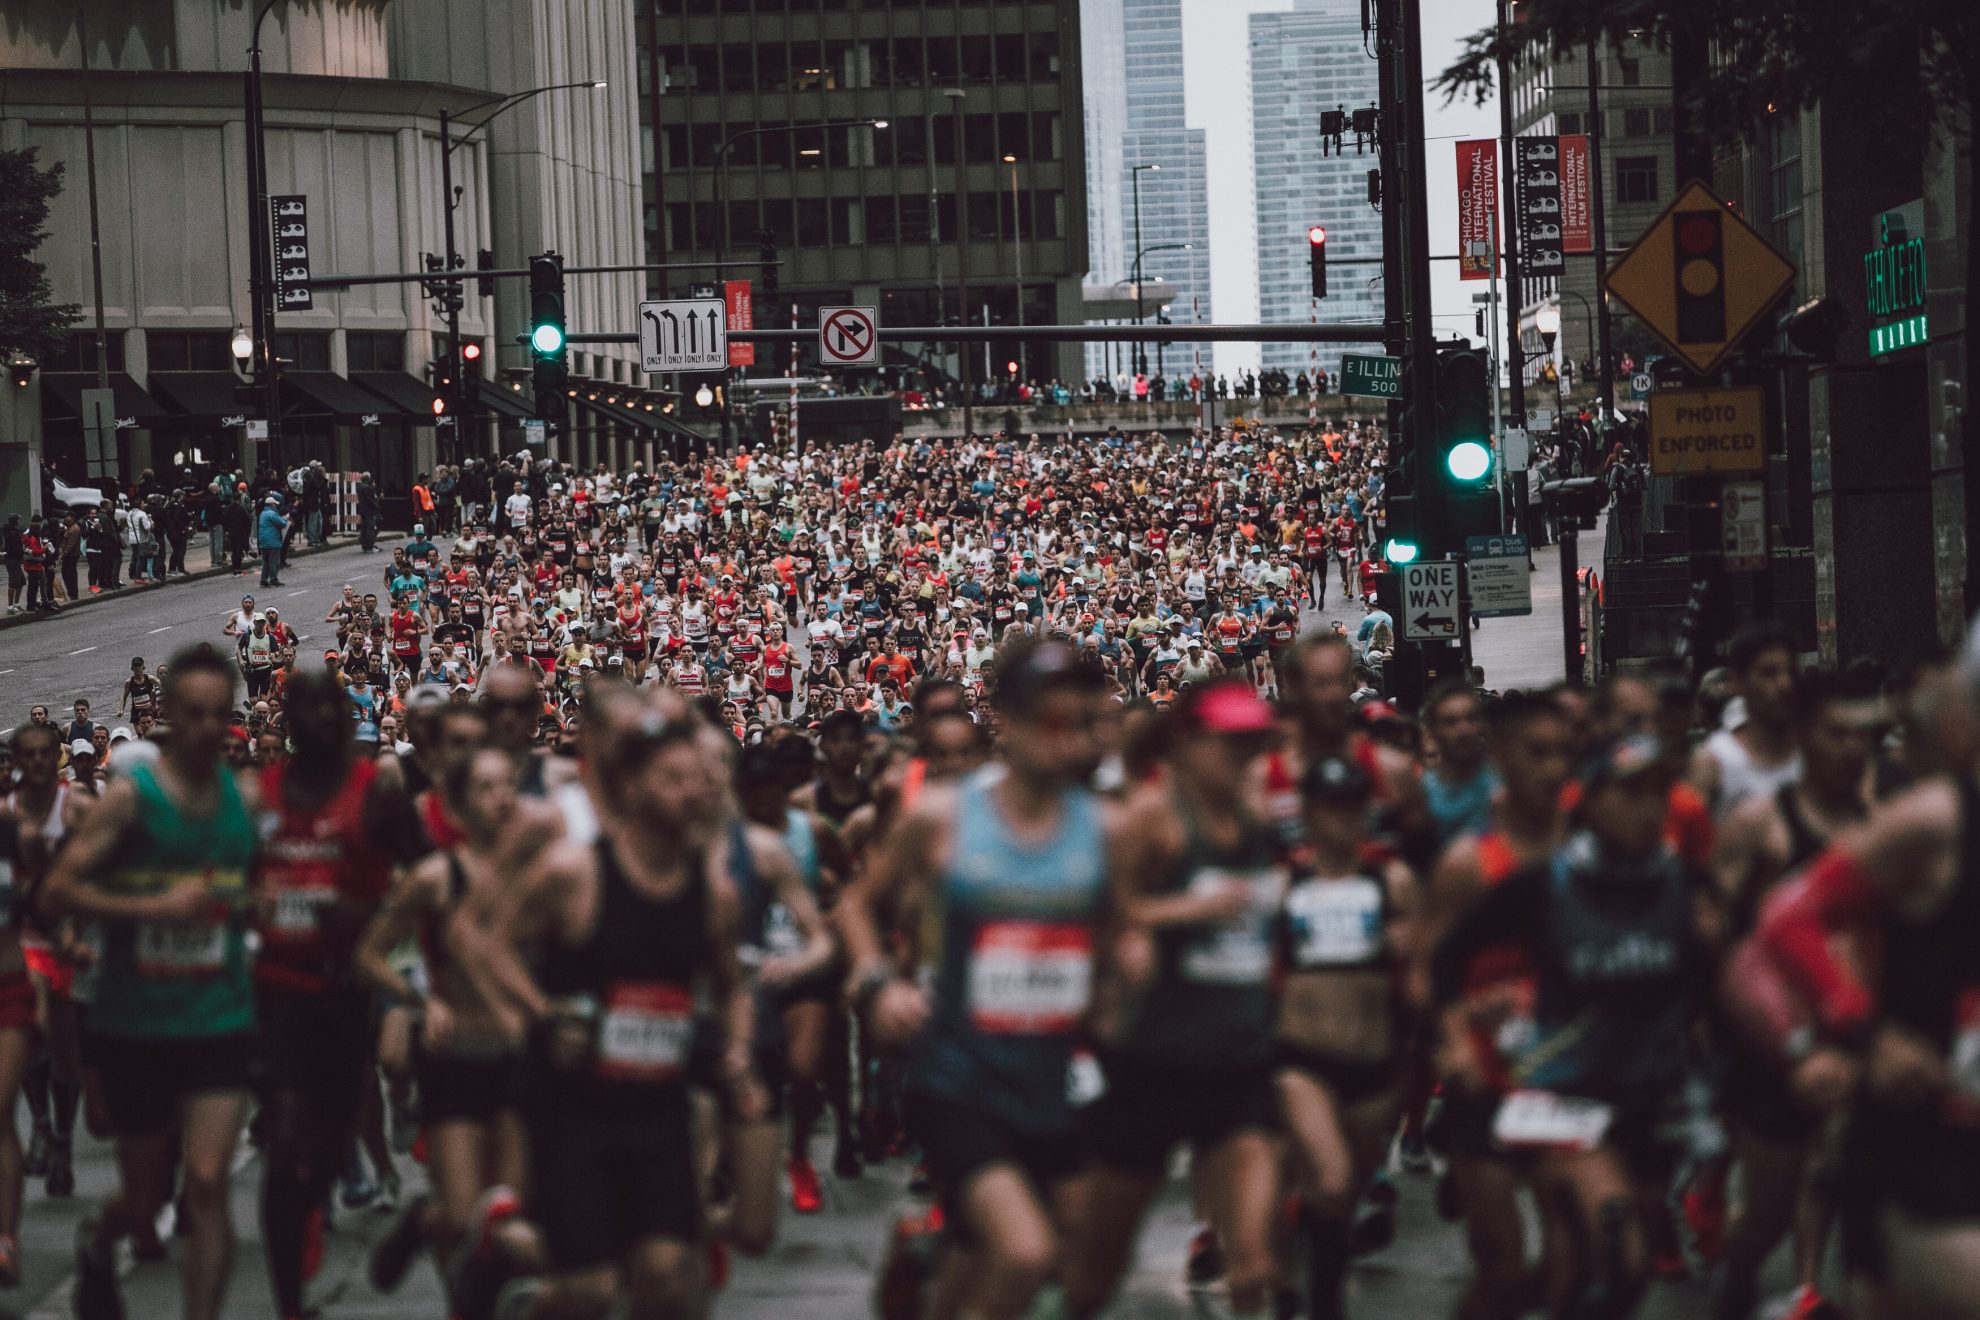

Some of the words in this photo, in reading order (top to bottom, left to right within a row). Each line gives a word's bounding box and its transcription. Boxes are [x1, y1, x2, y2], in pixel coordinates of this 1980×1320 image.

[1484, 155, 1494, 213] FESTIVAL
[1577, 152, 1586, 200] FESTIVAL
[1472, 148, 1483, 241] NTERNATIONAL
[1567, 147, 1577, 227] INTERNATIONAL
[1462, 189, 1471, 246] CHICAGO
[1578, 204, 1587, 226] FILM
[647, 356, 661, 365] ONLY
[668, 355, 682, 364] ONLY
[687, 354, 701, 363] ONLY
[707, 354, 721, 363] ONLY
[1347, 361, 1354, 373] E
[1371, 380, 1397, 393] 500
[1636, 376, 1648, 388] 1K
[1675, 405, 1737, 424] PHOTO
[1659, 433, 1755, 455] ENFORCED
[1505, 537, 1521, 546] bus
[1505, 545, 1525, 555] stop
[1409, 568, 1453, 587] ONE
[402, 583, 417, 592] JEAN
[1409, 589, 1454, 608] WAY
